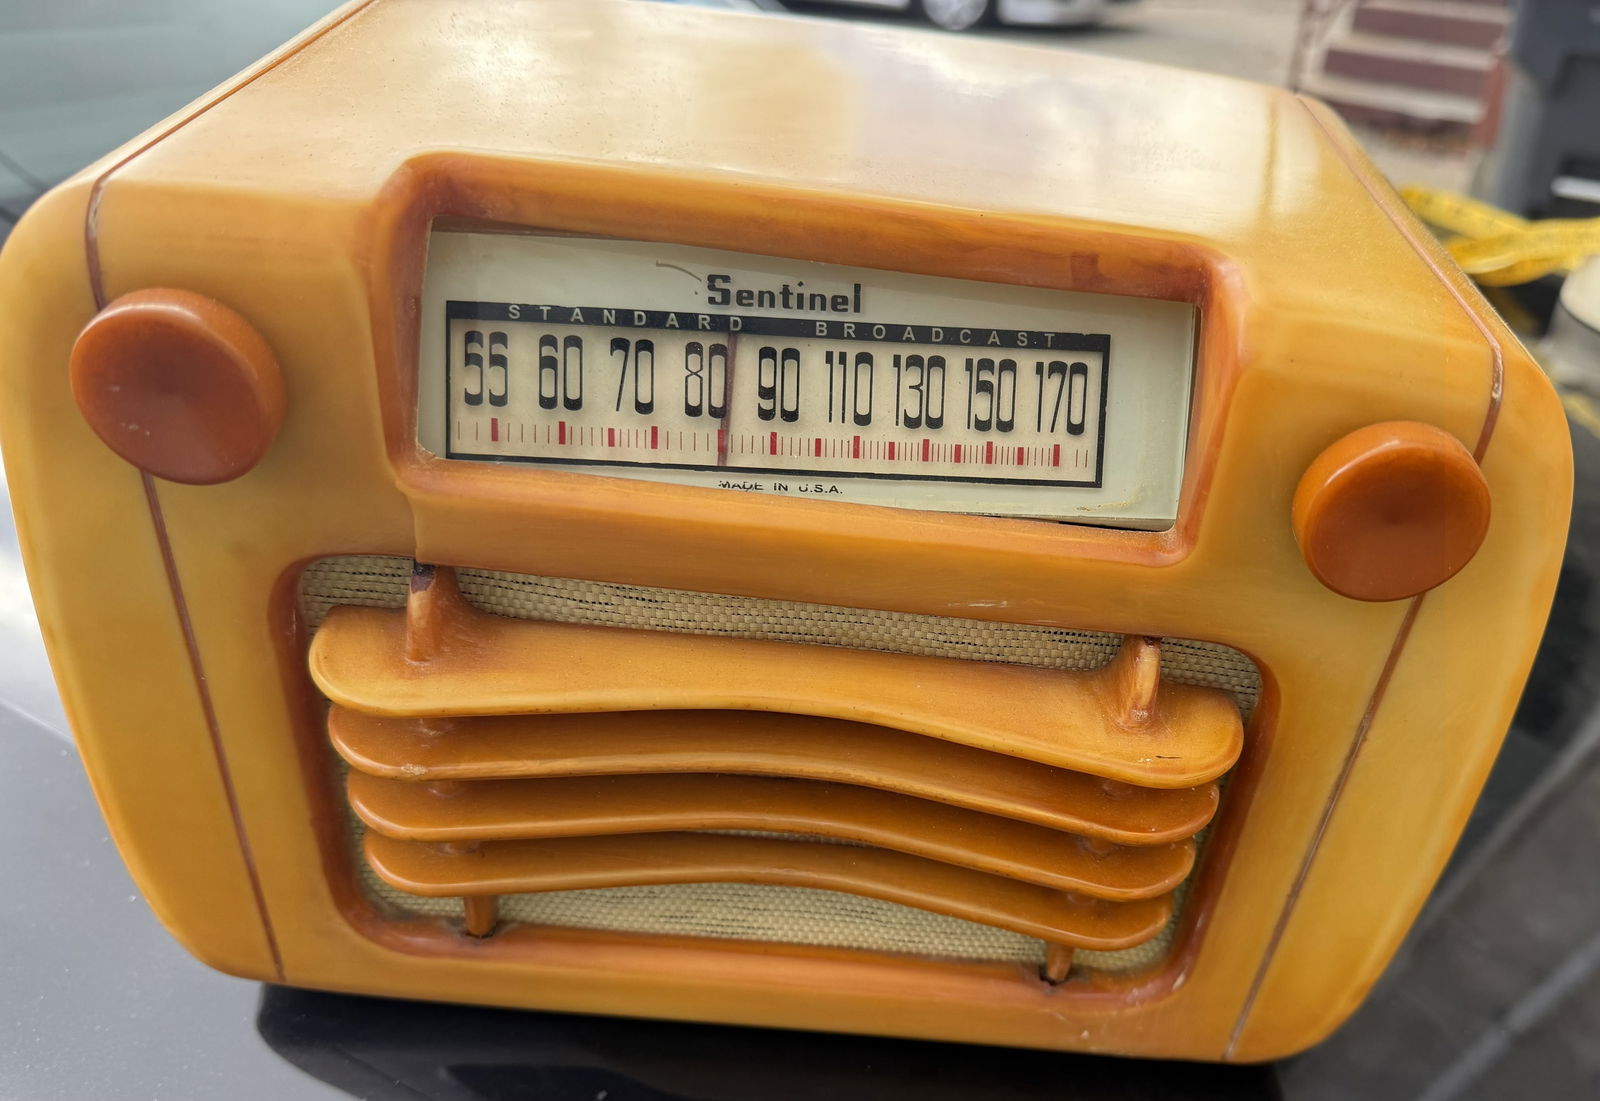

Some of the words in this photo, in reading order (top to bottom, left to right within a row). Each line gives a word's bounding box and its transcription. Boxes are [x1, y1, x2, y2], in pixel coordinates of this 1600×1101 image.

[707, 273, 862, 314] Sentinel
[507, 304, 743, 332] STANDARD
[814, 321, 1056, 348] BROADCAST
[464, 330, 508, 407] 55
[538, 334, 583, 411] 60
[610, 337, 655, 415] 70
[685, 341, 728, 419] 80
[757, 346, 801, 423] 90
[825, 350, 874, 427] 110
[892, 354, 947, 430] 130
[964, 357, 1018, 433] 150
[1036, 360, 1089, 436] 170
[718, 480, 765, 492] MADE
[773, 482, 789, 492] IN
[798, 483, 843, 494] U.S.A.
